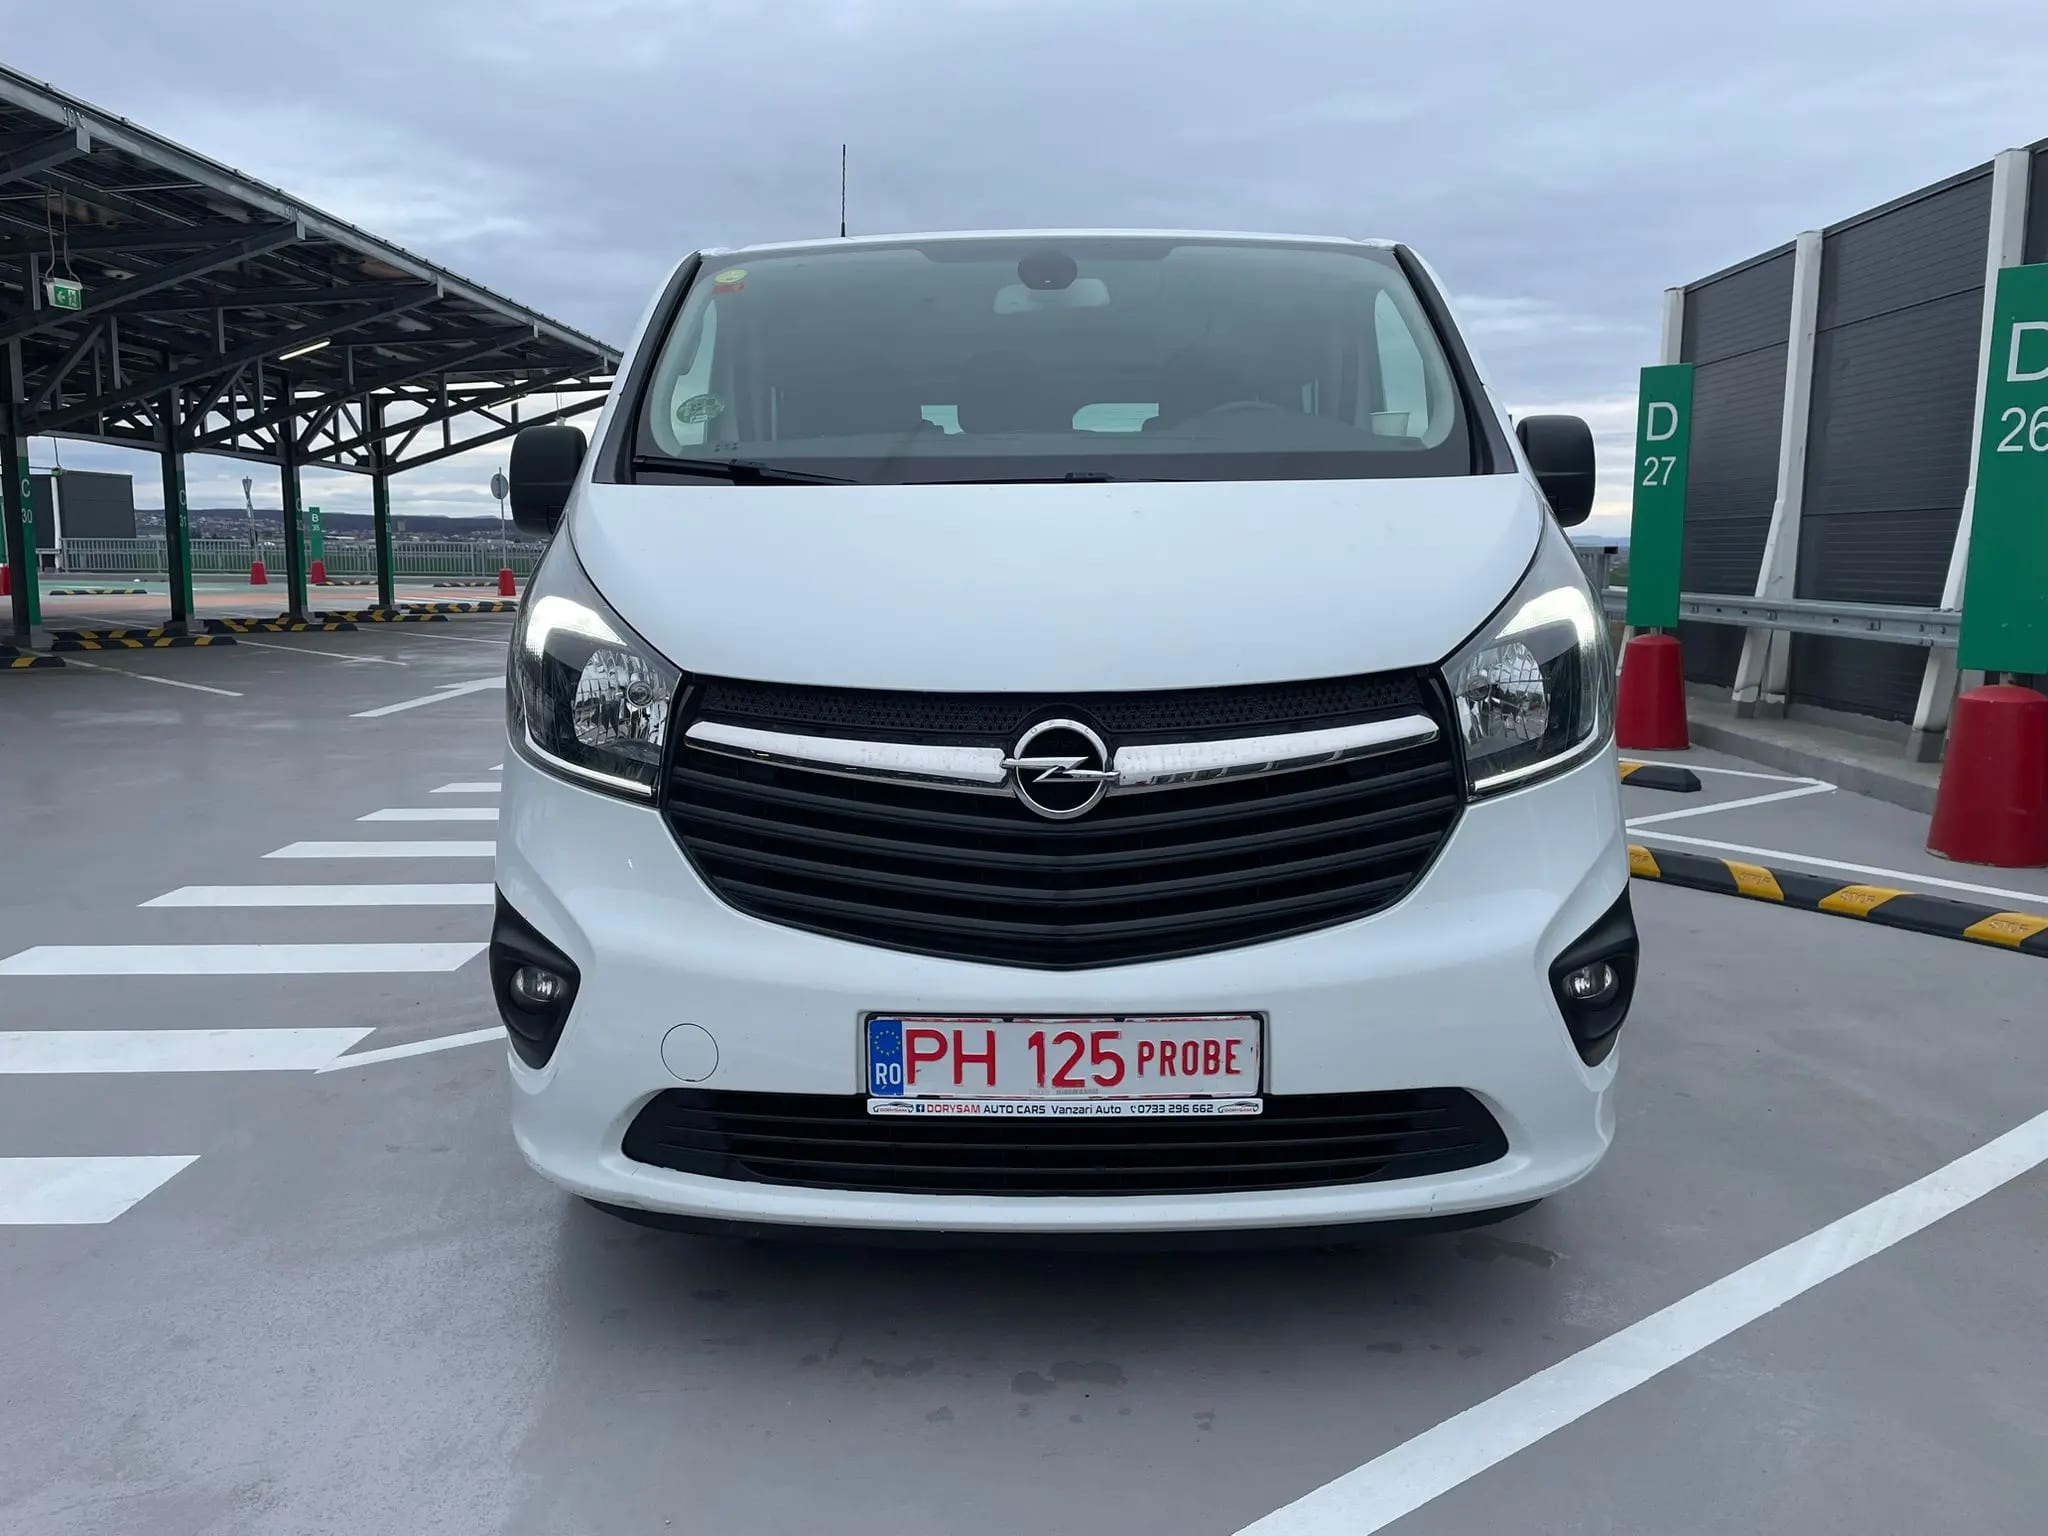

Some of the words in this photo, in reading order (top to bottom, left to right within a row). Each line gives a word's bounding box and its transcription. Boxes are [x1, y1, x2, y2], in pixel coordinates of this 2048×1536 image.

[2007, 321, 2048, 382] D
[1646, 401, 1679, 441] D
[1997, 406, 2048, 452] 26
[1642, 456, 1677, 486] 27
[21, 478, 31, 498] C
[21, 508, 33, 523] 30
[311, 513, 319, 522] B
[905, 1029, 996, 1087] PH
[1028, 1030, 1126, 1088] 125
[1136, 1039, 1243, 1078] PROBE
[875, 1062, 902, 1086] RO
[927, 1104, 980, 1113] DORYSAM
[983, 1105, 1014, 1114] AUTO
[1016, 1105, 1046, 1114] CARS
[1051, 1104, 1093, 1114] Vanzari
[1095, 1105, 1122, 1114] Auto
[1137, 1104, 1166, 1113] 0733
[1168, 1104, 1190, 1113] 296
[1192, 1104, 1214, 1113] 662
